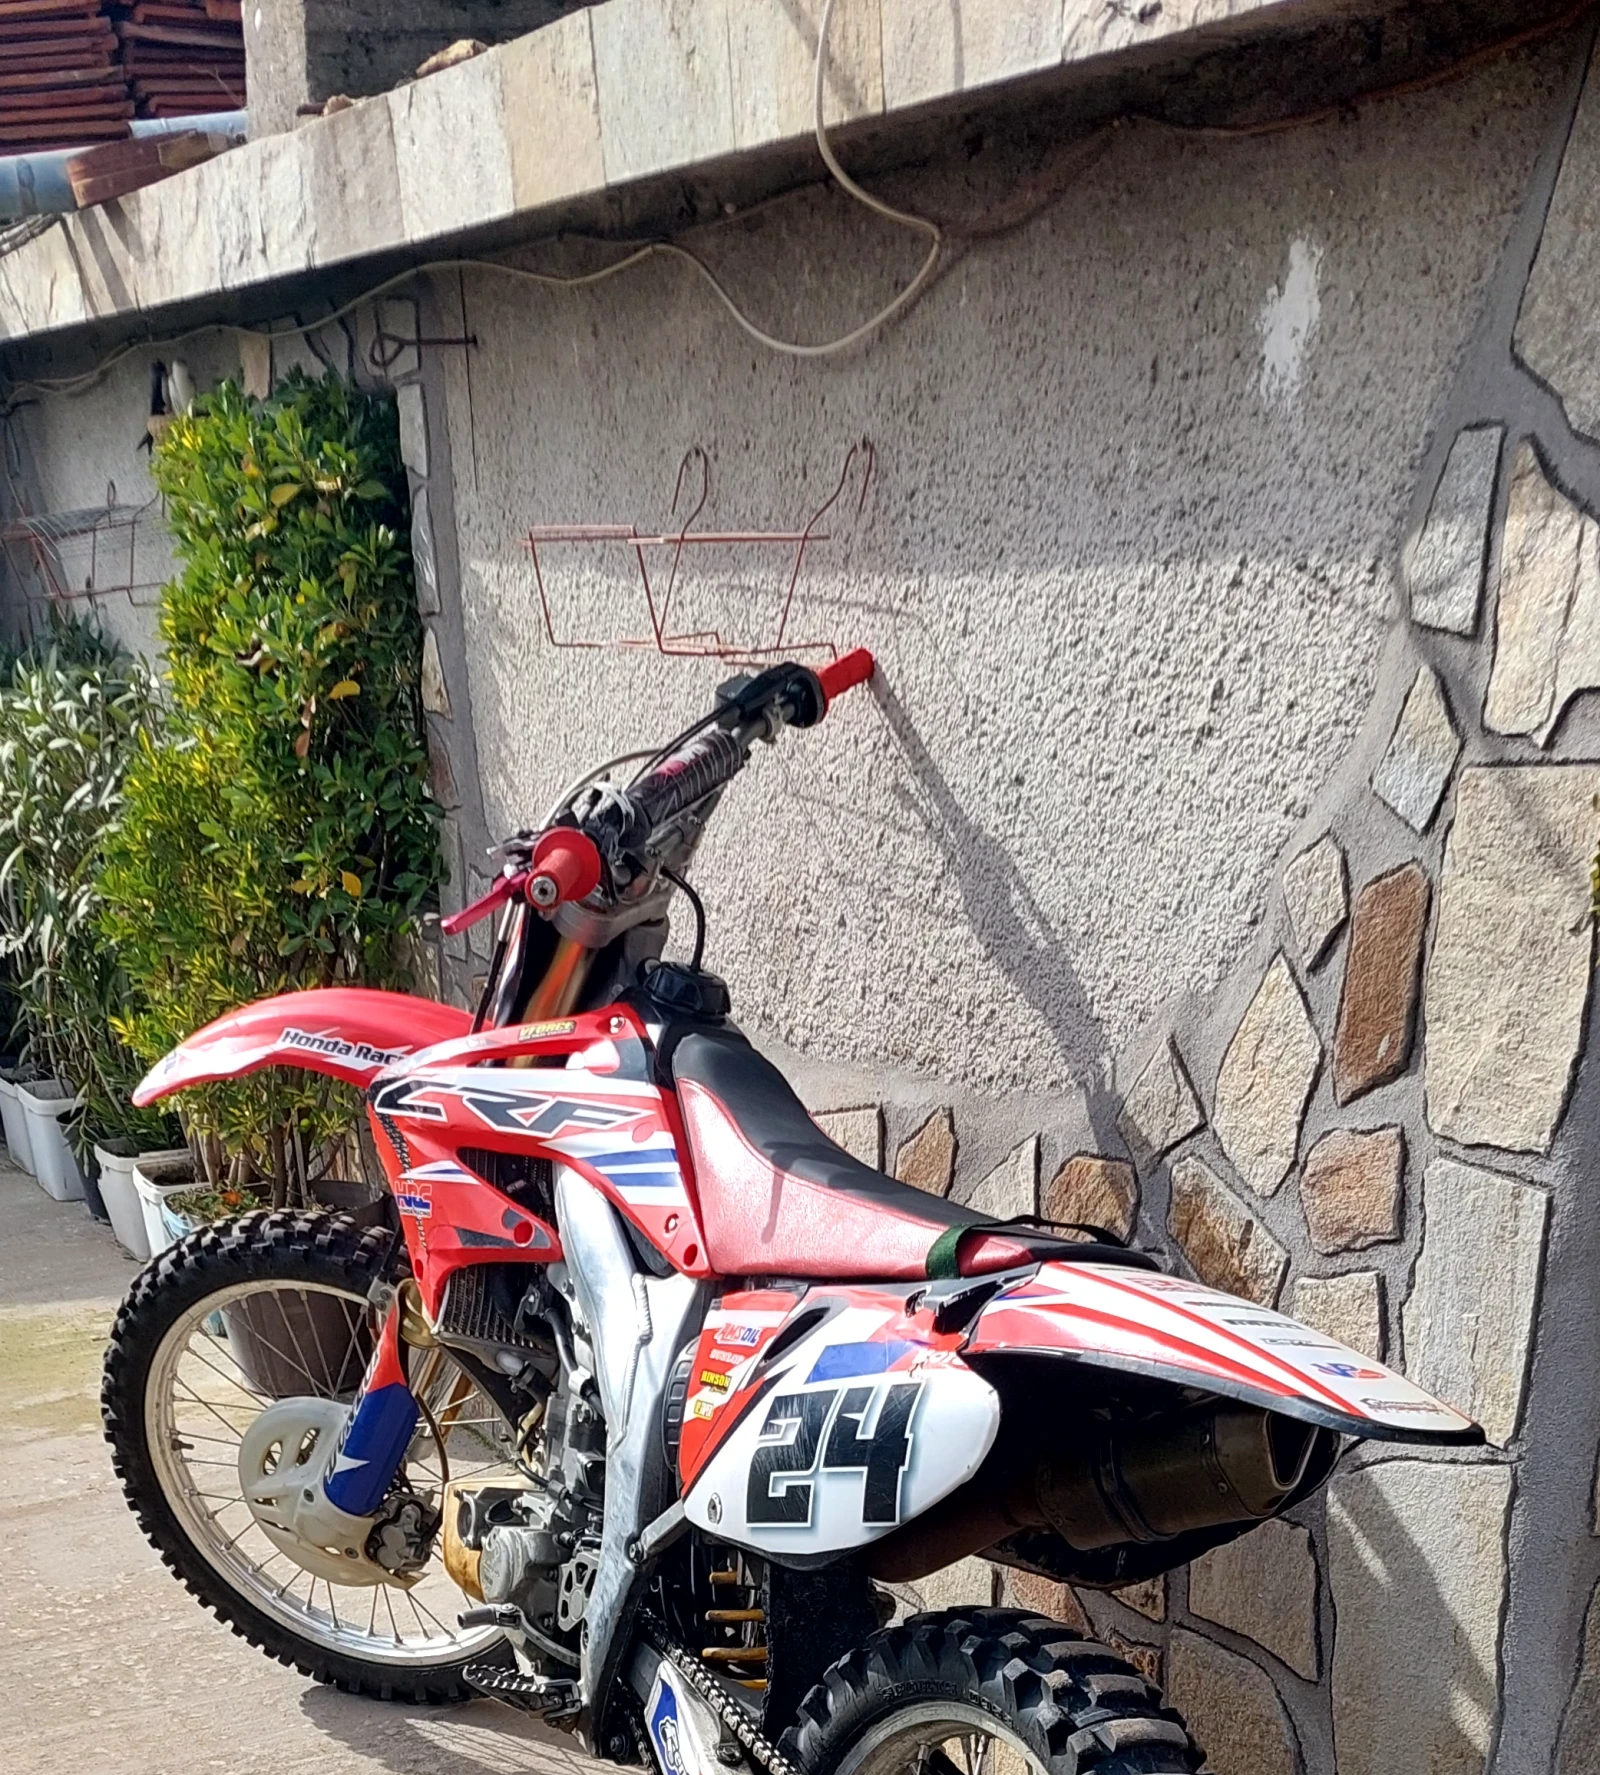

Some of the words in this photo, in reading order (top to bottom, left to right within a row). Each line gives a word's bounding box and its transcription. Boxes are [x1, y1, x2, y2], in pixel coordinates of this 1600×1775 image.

[282, 1030, 351, 1057] Honda
[355, 1044, 407, 1065] Rac
[376, 1076, 650, 1138] CRF
[394, 1180, 432, 1209] HRC
[715, 1322, 761, 1345] AMSOIL
[746, 1382, 922, 1526] 24
